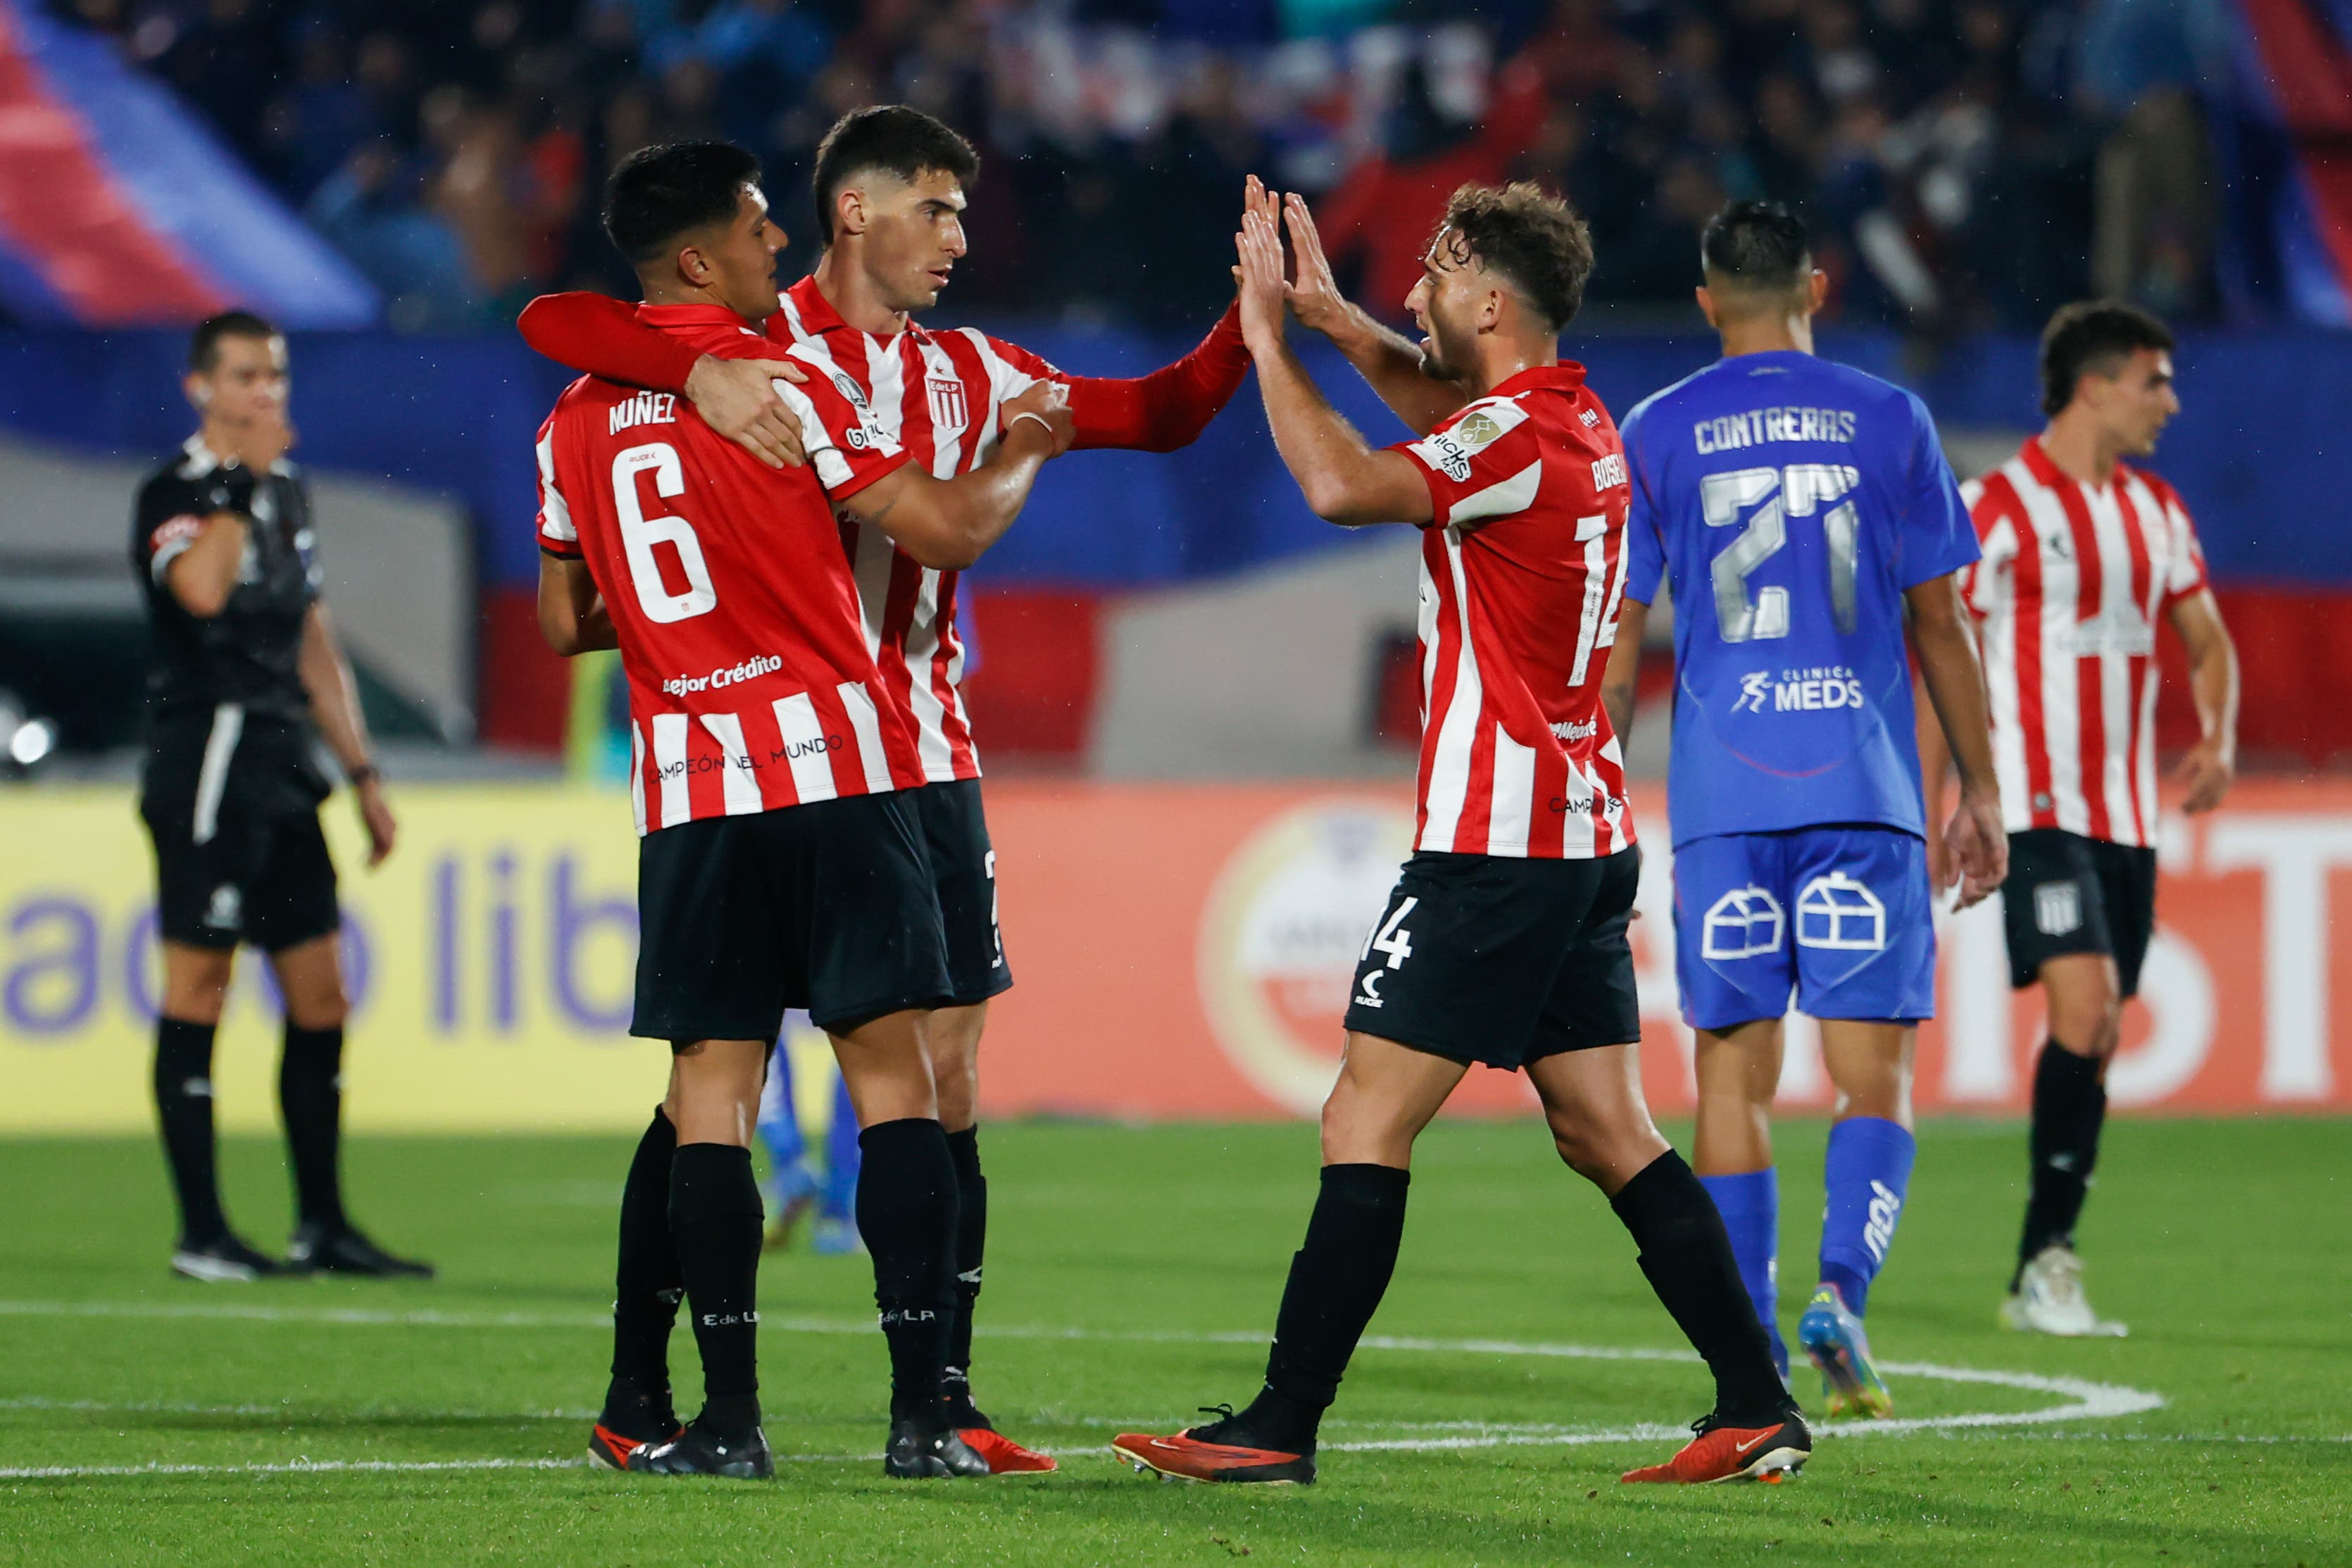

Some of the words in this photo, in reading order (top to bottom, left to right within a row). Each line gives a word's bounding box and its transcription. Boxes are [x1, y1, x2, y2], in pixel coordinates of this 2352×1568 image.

[609, 390, 676, 437] NUÑEZ
[1694, 406, 1857, 456] CONTRERAS
[611, 441, 718, 625] 6
[1699, 463, 1861, 644] 27
[711, 654, 783, 689] Crédito
[1774, 678, 1865, 713] MEDS
[647, 753, 726, 785] CAMPEÓN
[737, 755, 764, 770] EL
[770, 734, 844, 765] MUNDO
